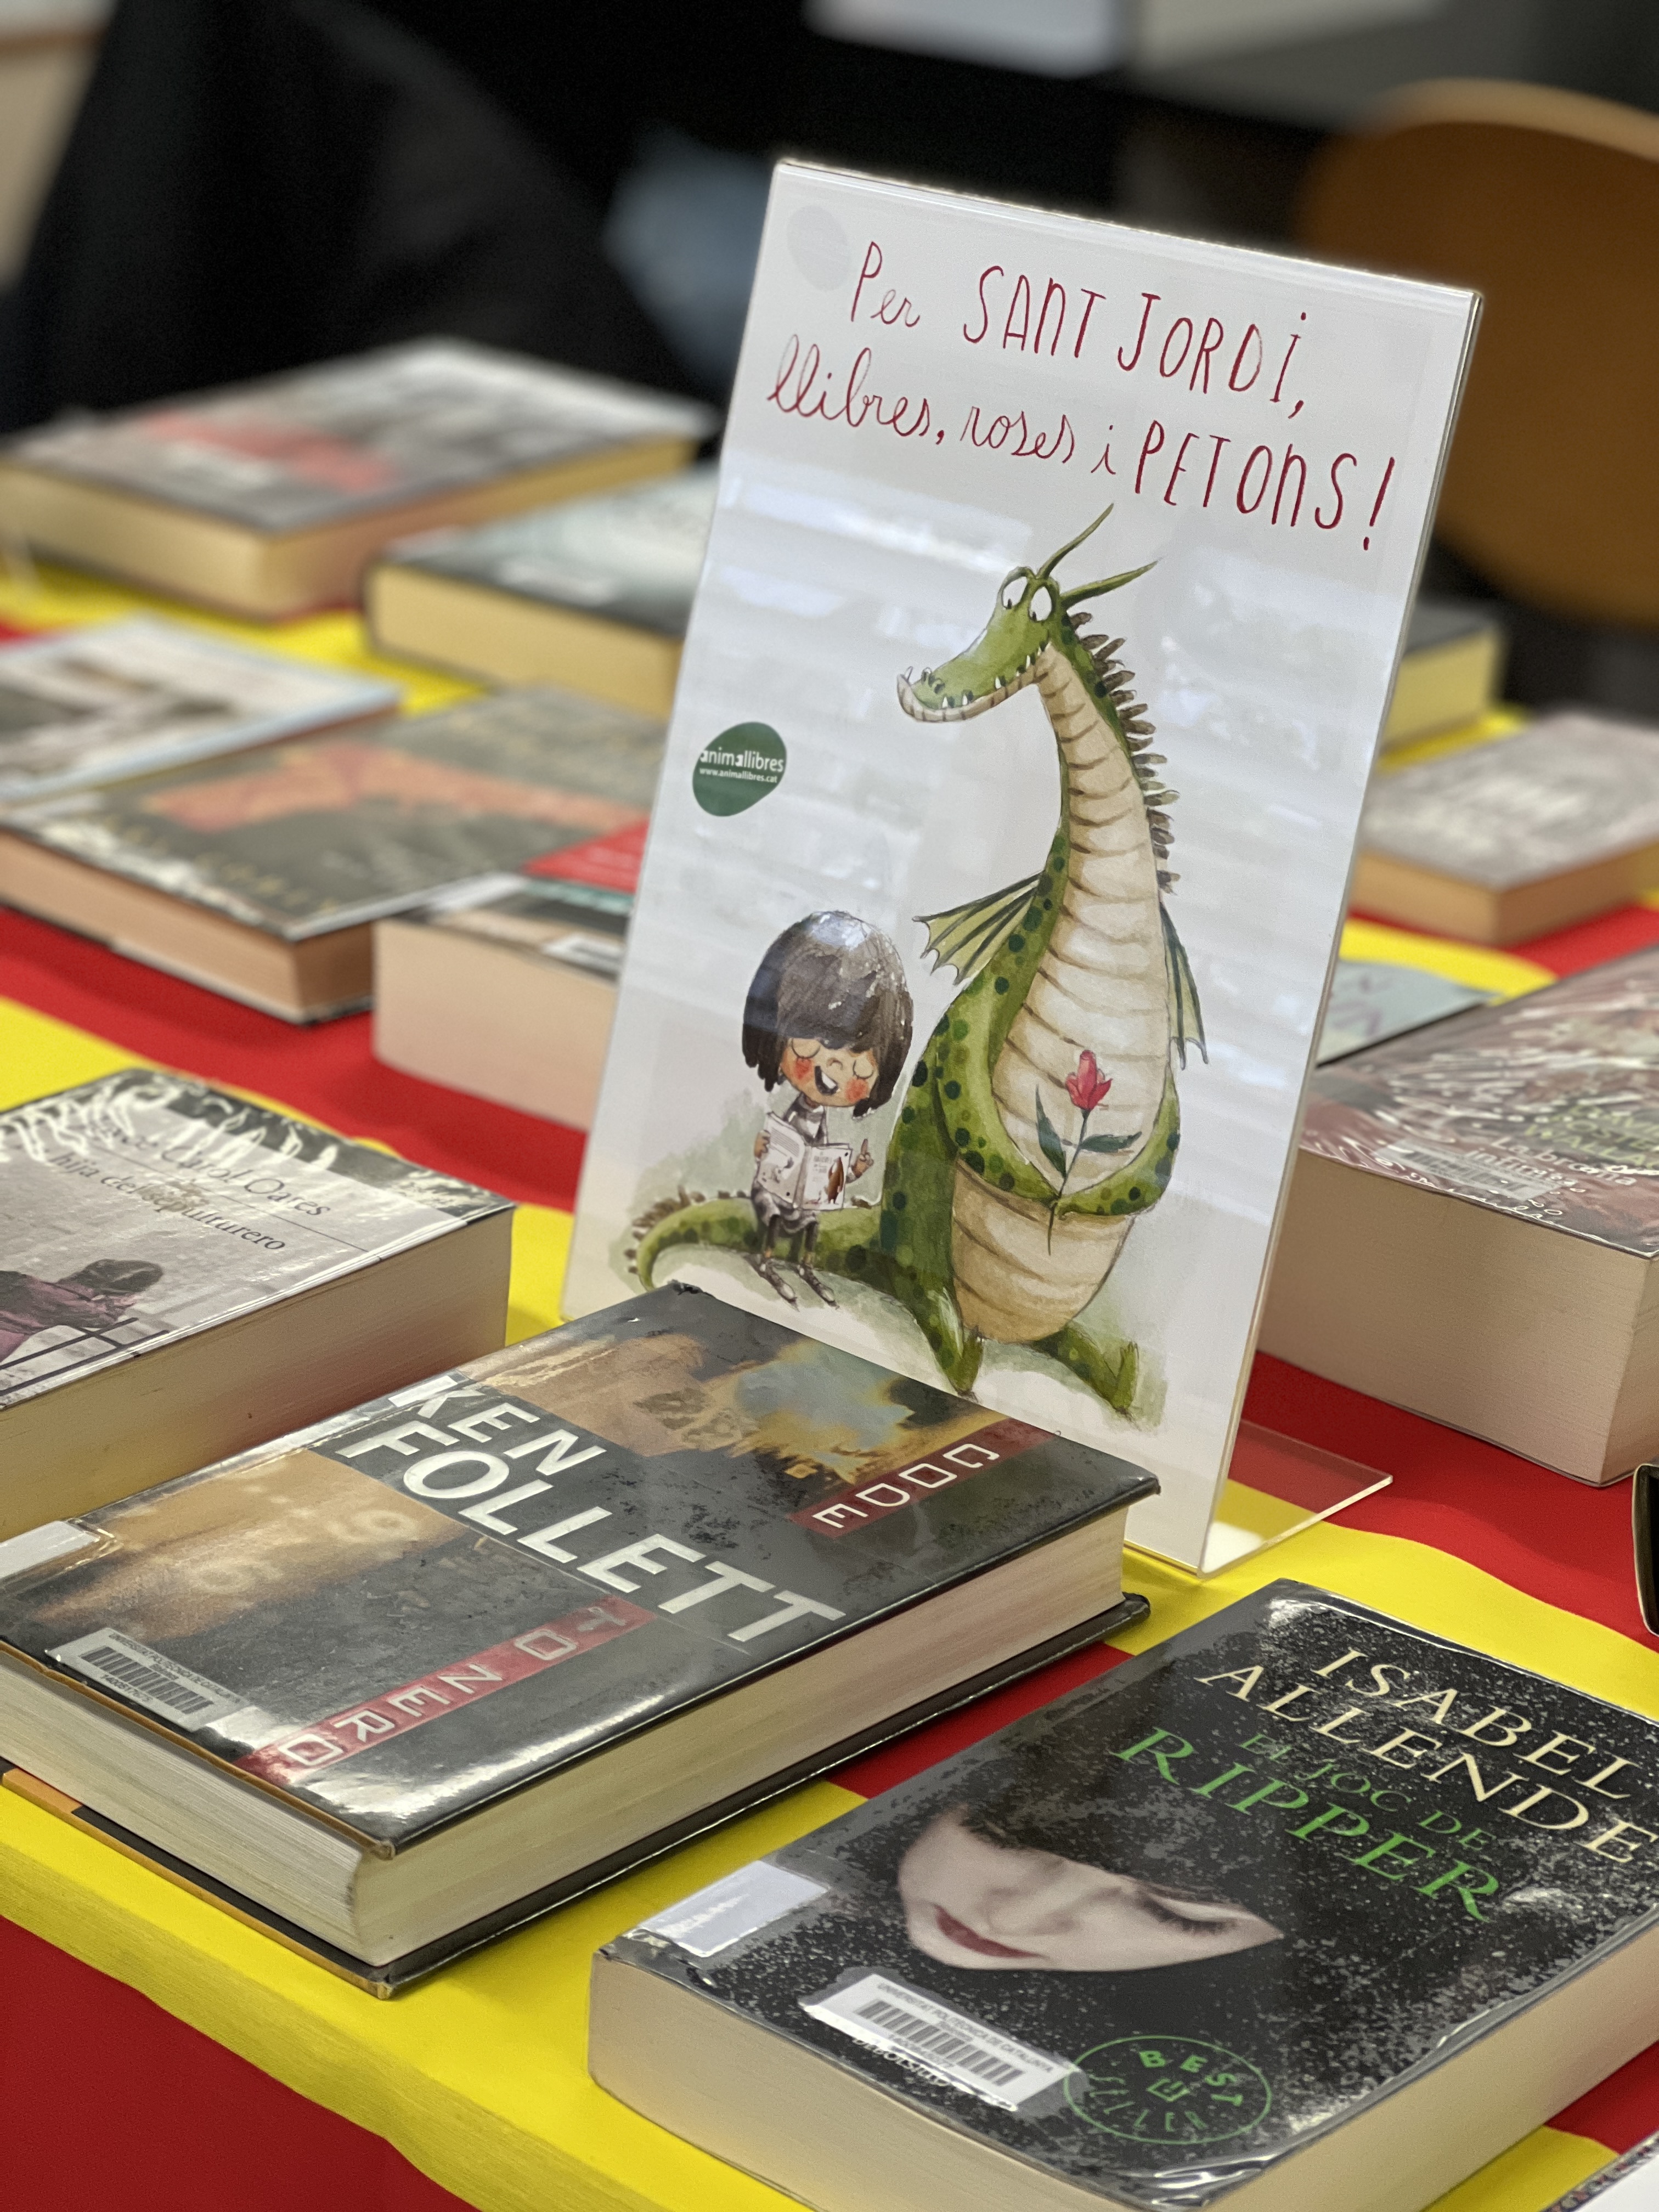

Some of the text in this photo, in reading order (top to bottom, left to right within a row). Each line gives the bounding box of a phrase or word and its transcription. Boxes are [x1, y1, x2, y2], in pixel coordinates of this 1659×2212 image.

[851, 241, 920, 328] Per
[767, 334, 944, 445] llibres,
[960, 407, 1075, 464] roses
[1091, 425, 1116, 475] i
[699, 747, 785, 772] animallibres
[699, 768, 778, 783] www.animallibres.cat
[48, 1152, 286, 1250] hija del sepulturero
[387, 1375, 607, 1476] KEN
[334, 1420, 847, 1642] FOLLETT
[812, 1443, 1000, 1528] CODE
[1195, 1664, 1658, 1865] ALLENDE
[1314, 1647, 1643, 1800] ISABEL
[1110, 1726, 1500, 1923] RIPPER
[1237, 1733, 1498, 1852] EL JOC DE
[1138, 2050, 1244, 2107] BEST
